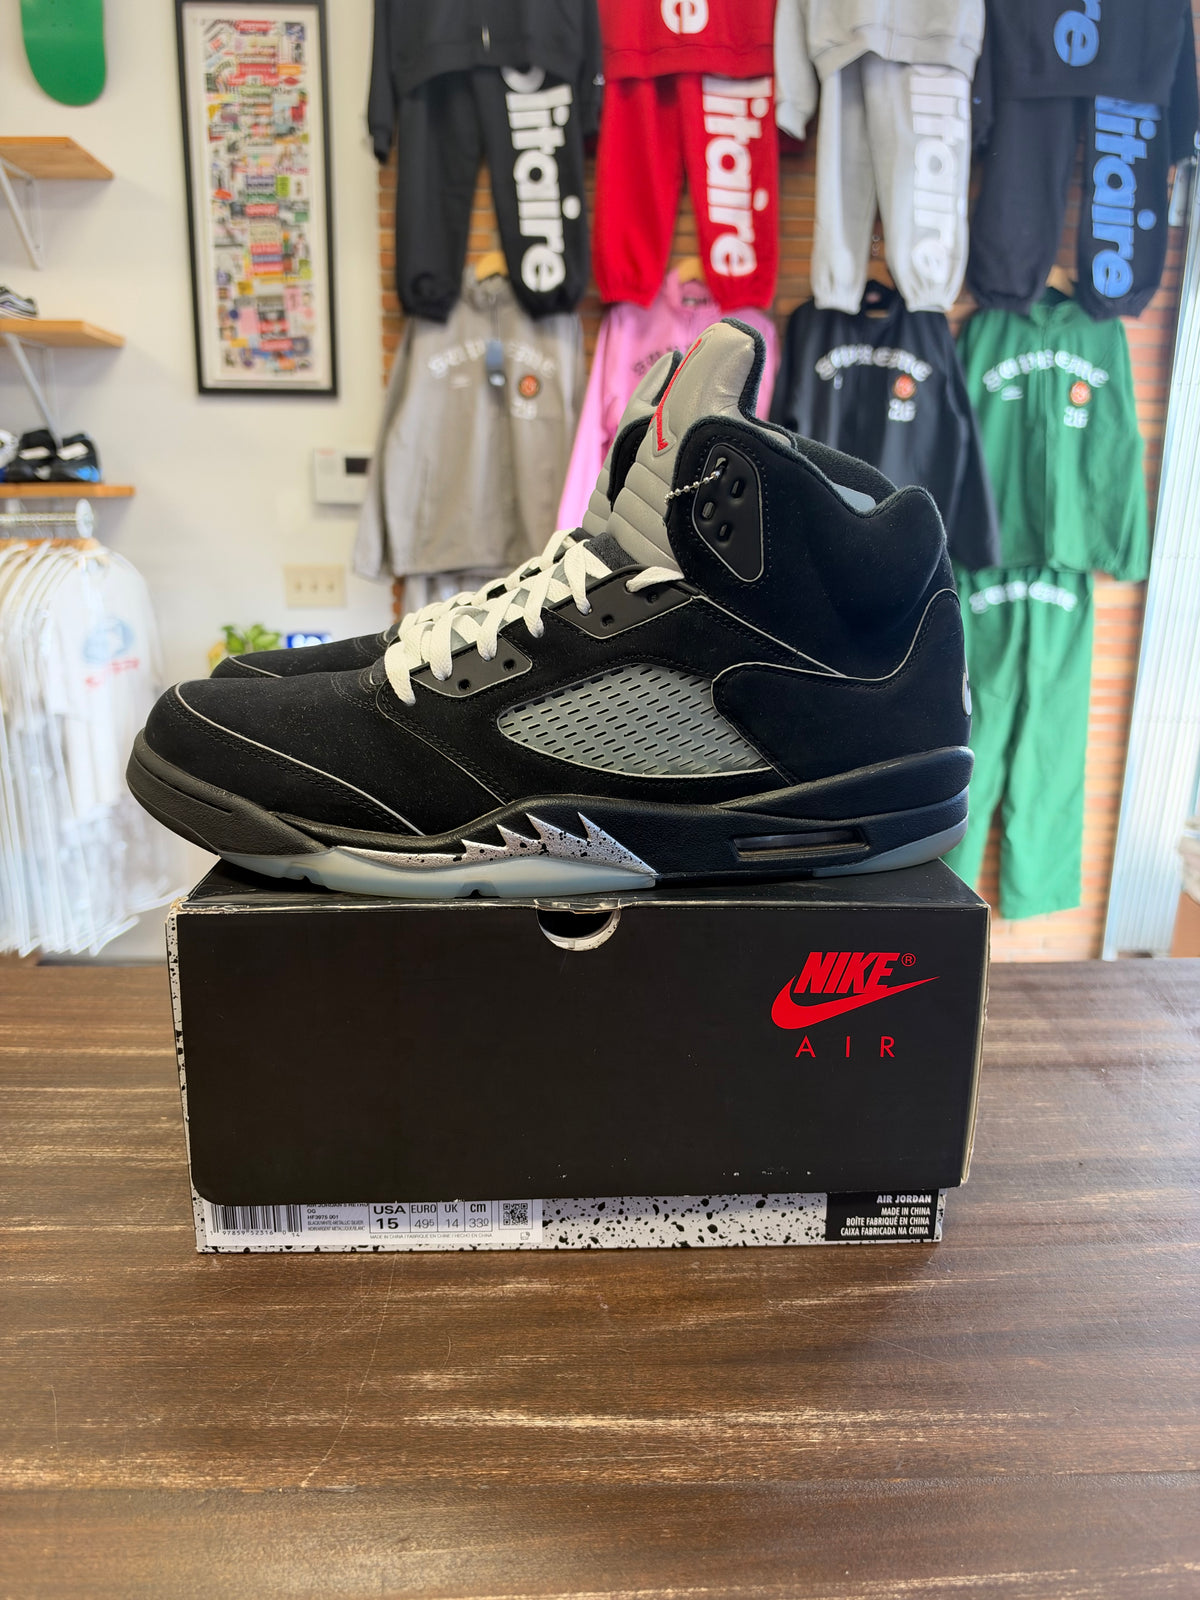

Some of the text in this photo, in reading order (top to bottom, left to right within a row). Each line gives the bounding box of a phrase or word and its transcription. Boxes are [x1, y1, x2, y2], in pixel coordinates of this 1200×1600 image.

[795, 1035, 895, 1058] AIR
[877, 1194, 932, 1204] AIR JORDAN
[373, 1203, 486, 1214] USA EURO UK cm
[881, 1206, 931, 1216] MADE IN CHINA
[376, 1218, 399, 1229] 15
[446, 1218, 459, 1228] 14
[846, 1215, 930, 1226] BOÎTE FABRIQUÉ EN CHINA
[840, 1226, 929, 1236] CAIXA FABRICADA NA CHINA
